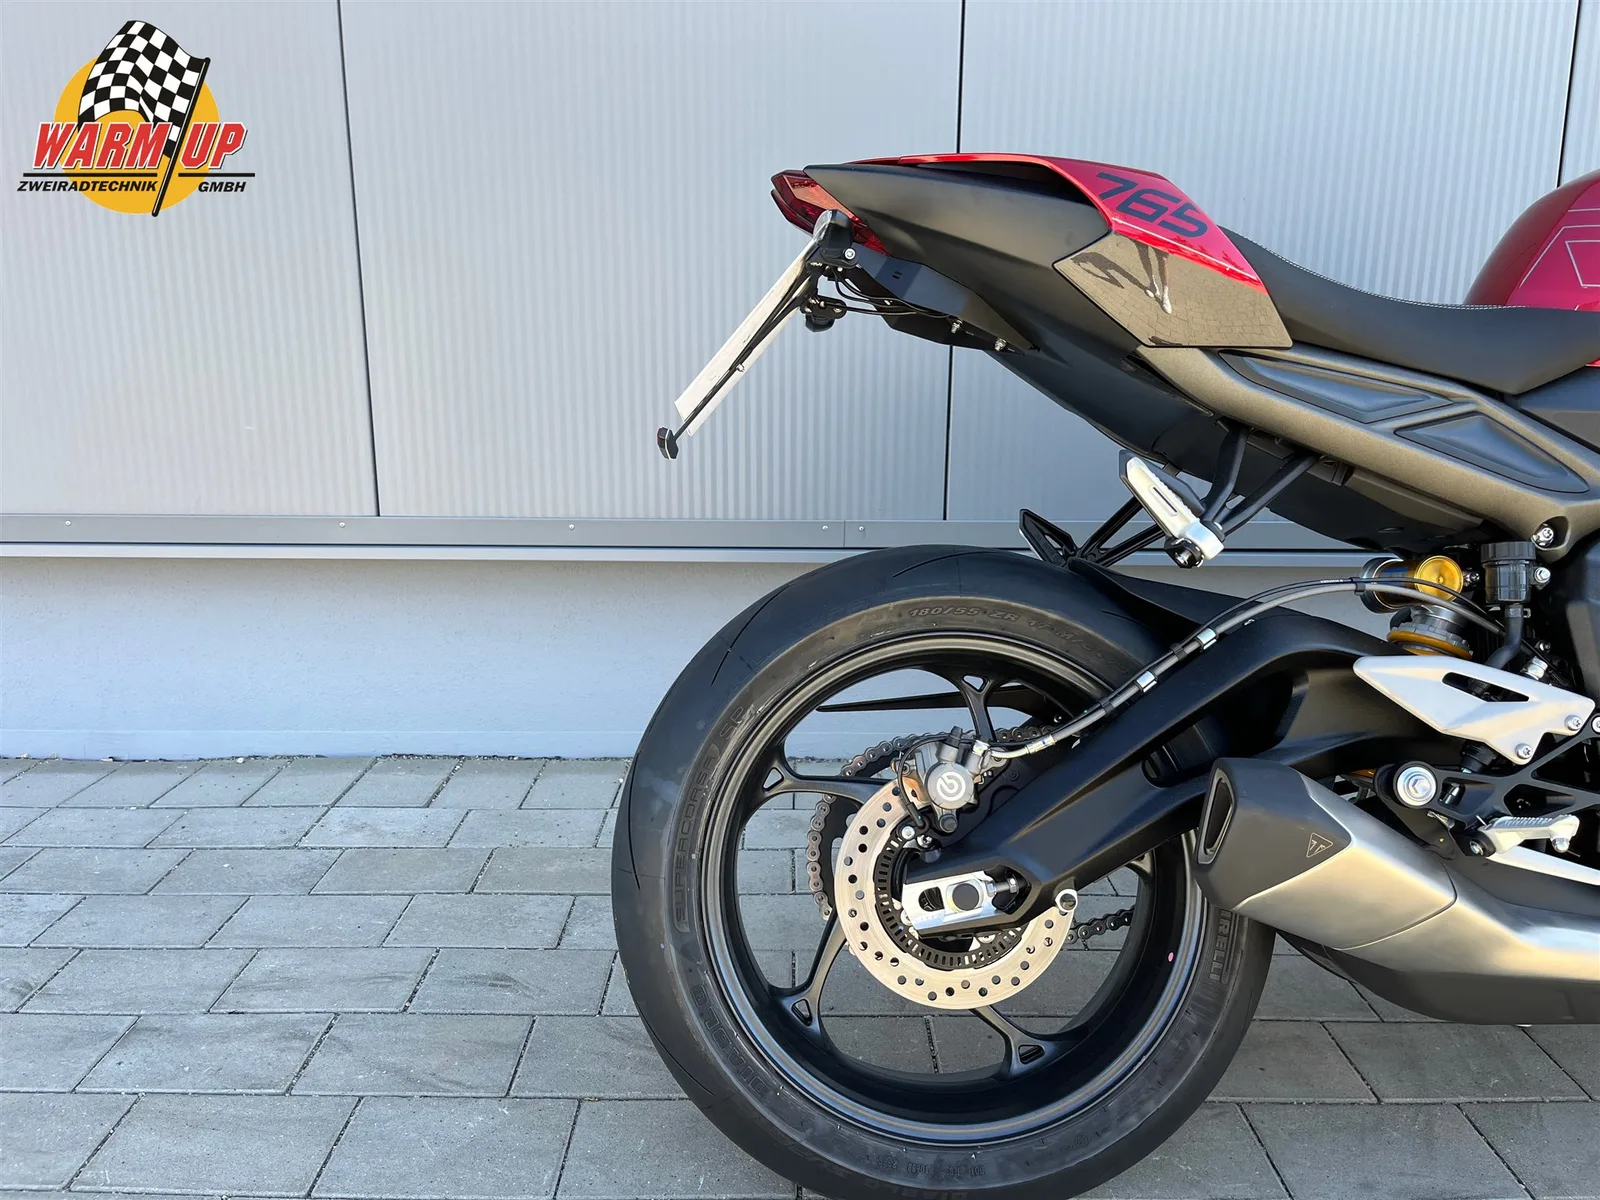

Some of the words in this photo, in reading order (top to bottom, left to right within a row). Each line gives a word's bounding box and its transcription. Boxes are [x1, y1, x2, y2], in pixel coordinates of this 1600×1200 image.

[1096, 172, 1208, 237] 765
[908, 606, 980, 618] 180/55
[989, 610, 1020, 622] ZR
[674, 753, 718, 921] SUPERCORSA
[1209, 909, 1231, 981] IRELLI
[691, 984, 769, 1097] DIABLO
